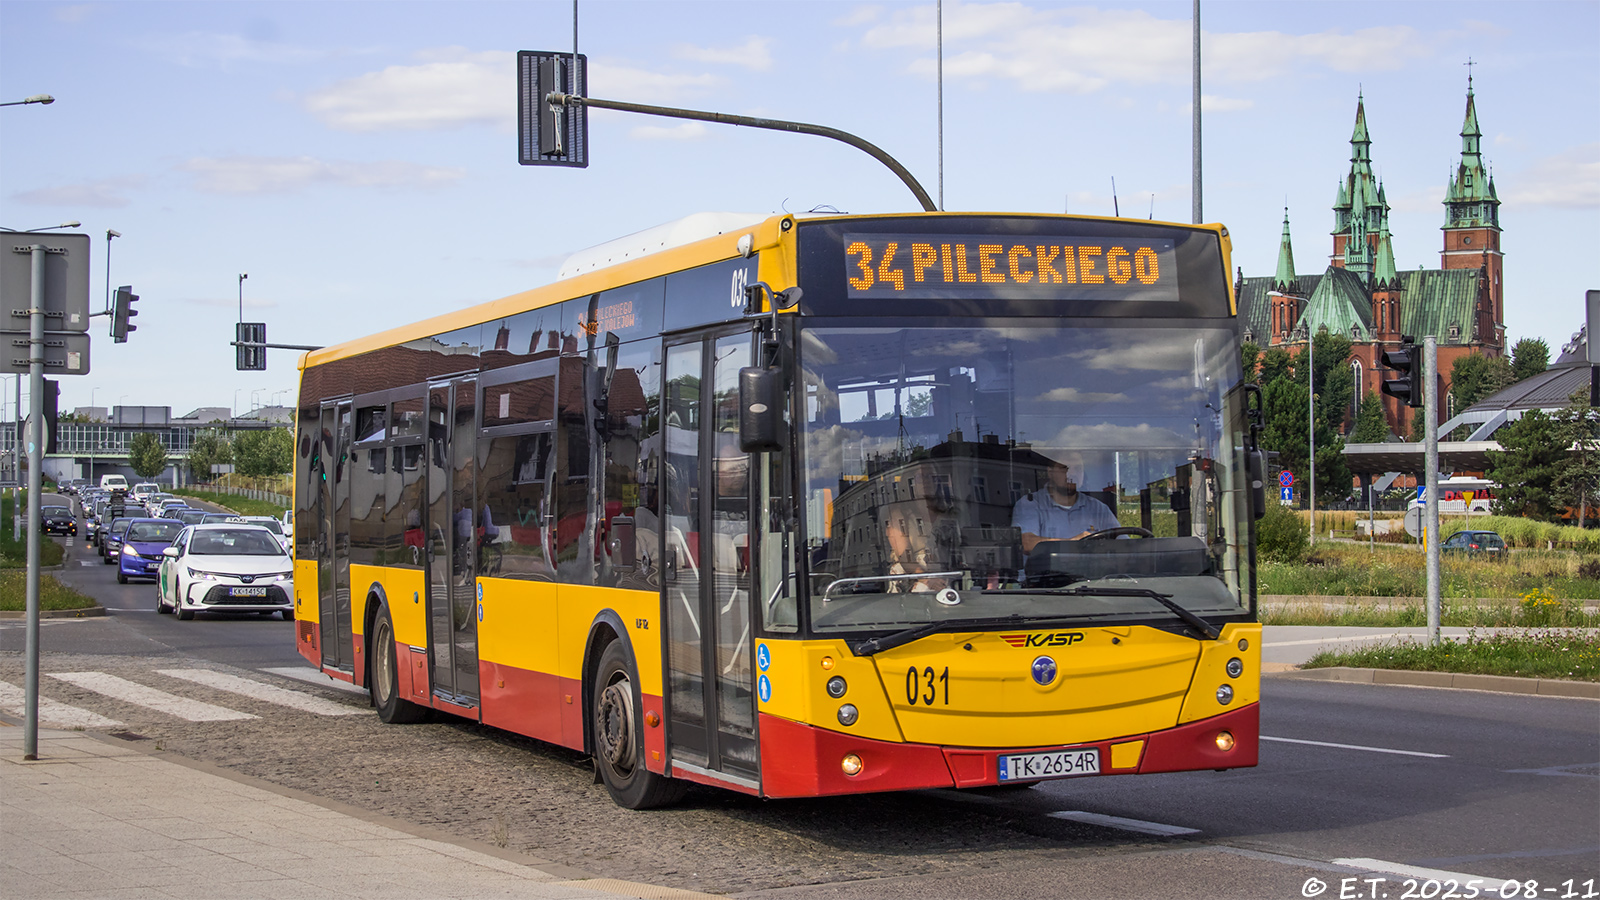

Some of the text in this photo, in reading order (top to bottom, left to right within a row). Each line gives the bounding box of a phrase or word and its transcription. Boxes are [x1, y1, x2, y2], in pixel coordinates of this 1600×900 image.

[847, 242, 1159, 291] 34 PILECKIEGO
[731, 268, 748, 307] 031
[1025, 632, 1085, 648] KASP
[906, 666, 949, 705] 031
[1011, 752, 1096, 777] TK 2654R
